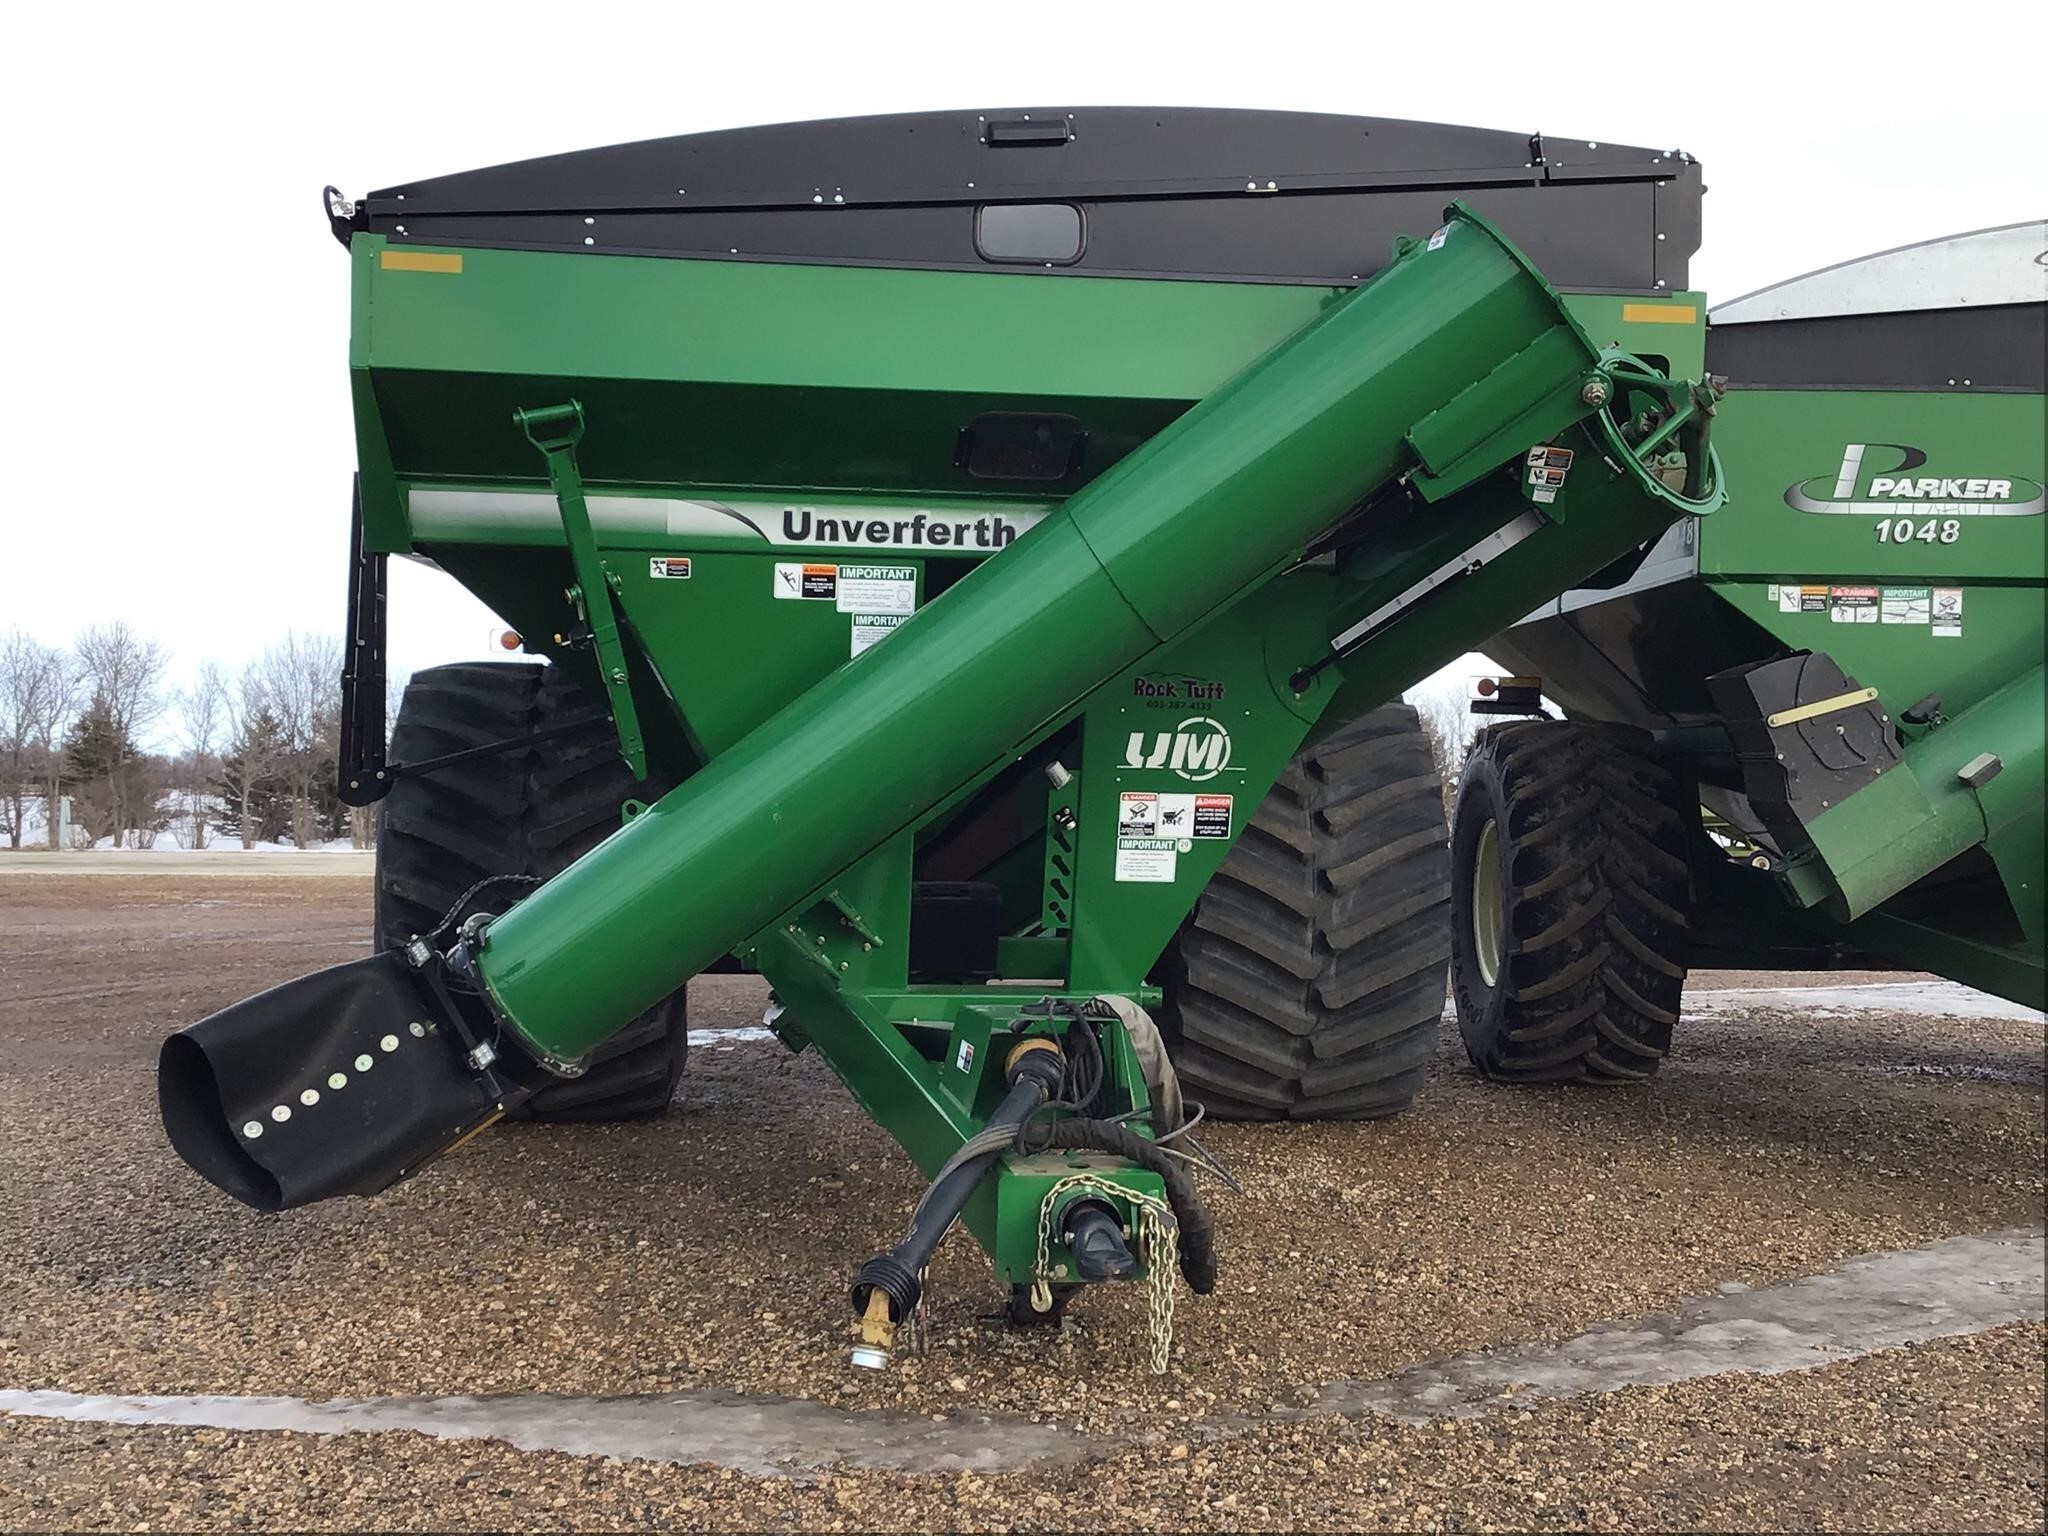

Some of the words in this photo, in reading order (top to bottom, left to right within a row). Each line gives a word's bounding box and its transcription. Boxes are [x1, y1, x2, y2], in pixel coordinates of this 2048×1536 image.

[1868, 478, 2012, 499] PARKER
[783, 510, 1016, 547] Unverferth
[1875, 518, 1961, 544] 1048
[842, 567, 912, 580] IMPORTANT
[1883, 589, 1929, 598] IMPORTANT
[855, 615, 910, 626] IMPORTAN
[1133, 677, 1178, 698] Rock
[1181, 680, 1225, 700] Tuff
[1120, 840, 1174, 850] IMPORTANT
